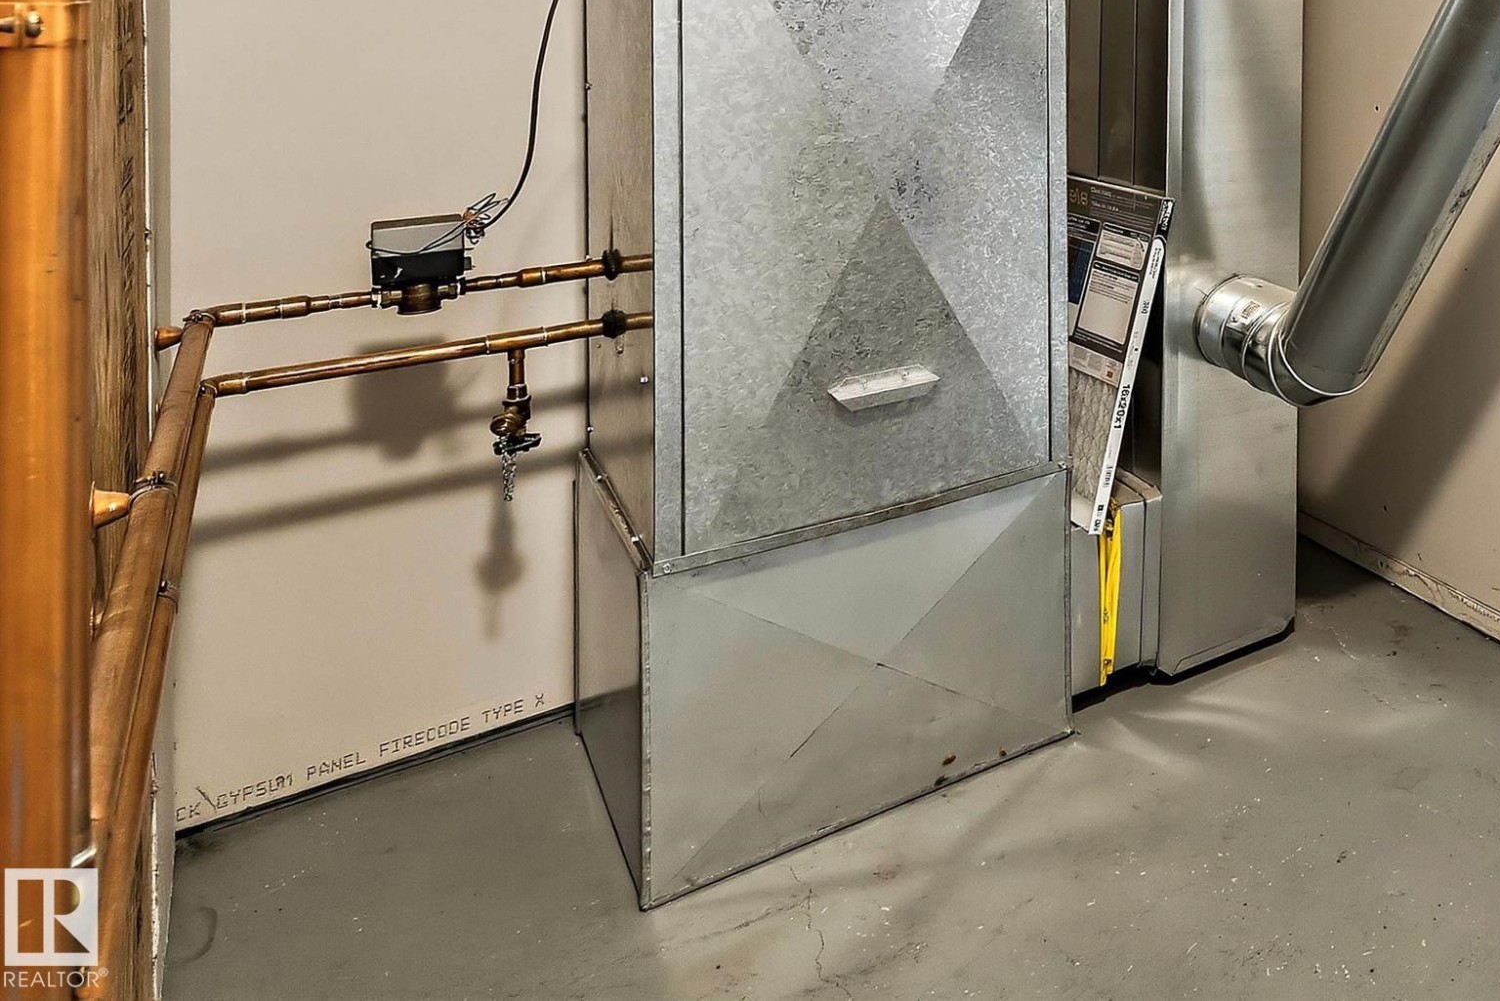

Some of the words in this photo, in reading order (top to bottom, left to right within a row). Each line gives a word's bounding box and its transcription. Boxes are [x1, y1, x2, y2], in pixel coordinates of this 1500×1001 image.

[306, 751, 367, 781] PANEL
[378, 716, 471, 758] FIRECODE
[481, 699, 525, 724] TYPE
[534, 692, 545, 708] X
